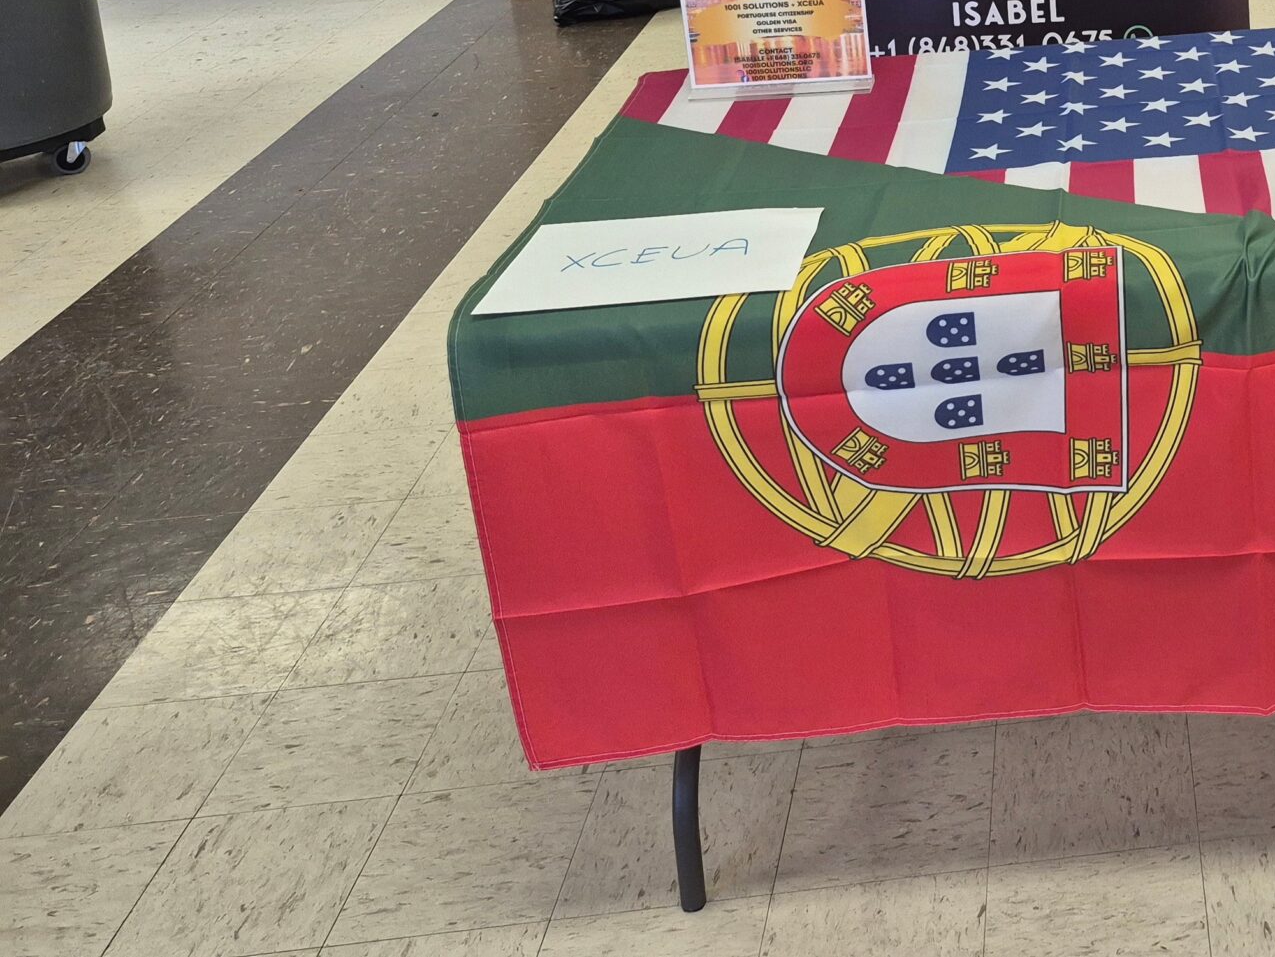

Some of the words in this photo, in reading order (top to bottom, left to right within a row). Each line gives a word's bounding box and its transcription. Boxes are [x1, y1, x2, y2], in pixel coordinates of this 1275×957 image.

[743, 1, 790, 10] SOLUTIONS
[797, 0, 825, 7] XCEUA
[870, 38, 897, 56] +1
[908, 29, 1113, 55] (848)3310675
[759, 47, 793, 55] CONTACT
[767, 73, 808, 81] SOLUTIONS
[560, 237, 749, 272] XCEUA
